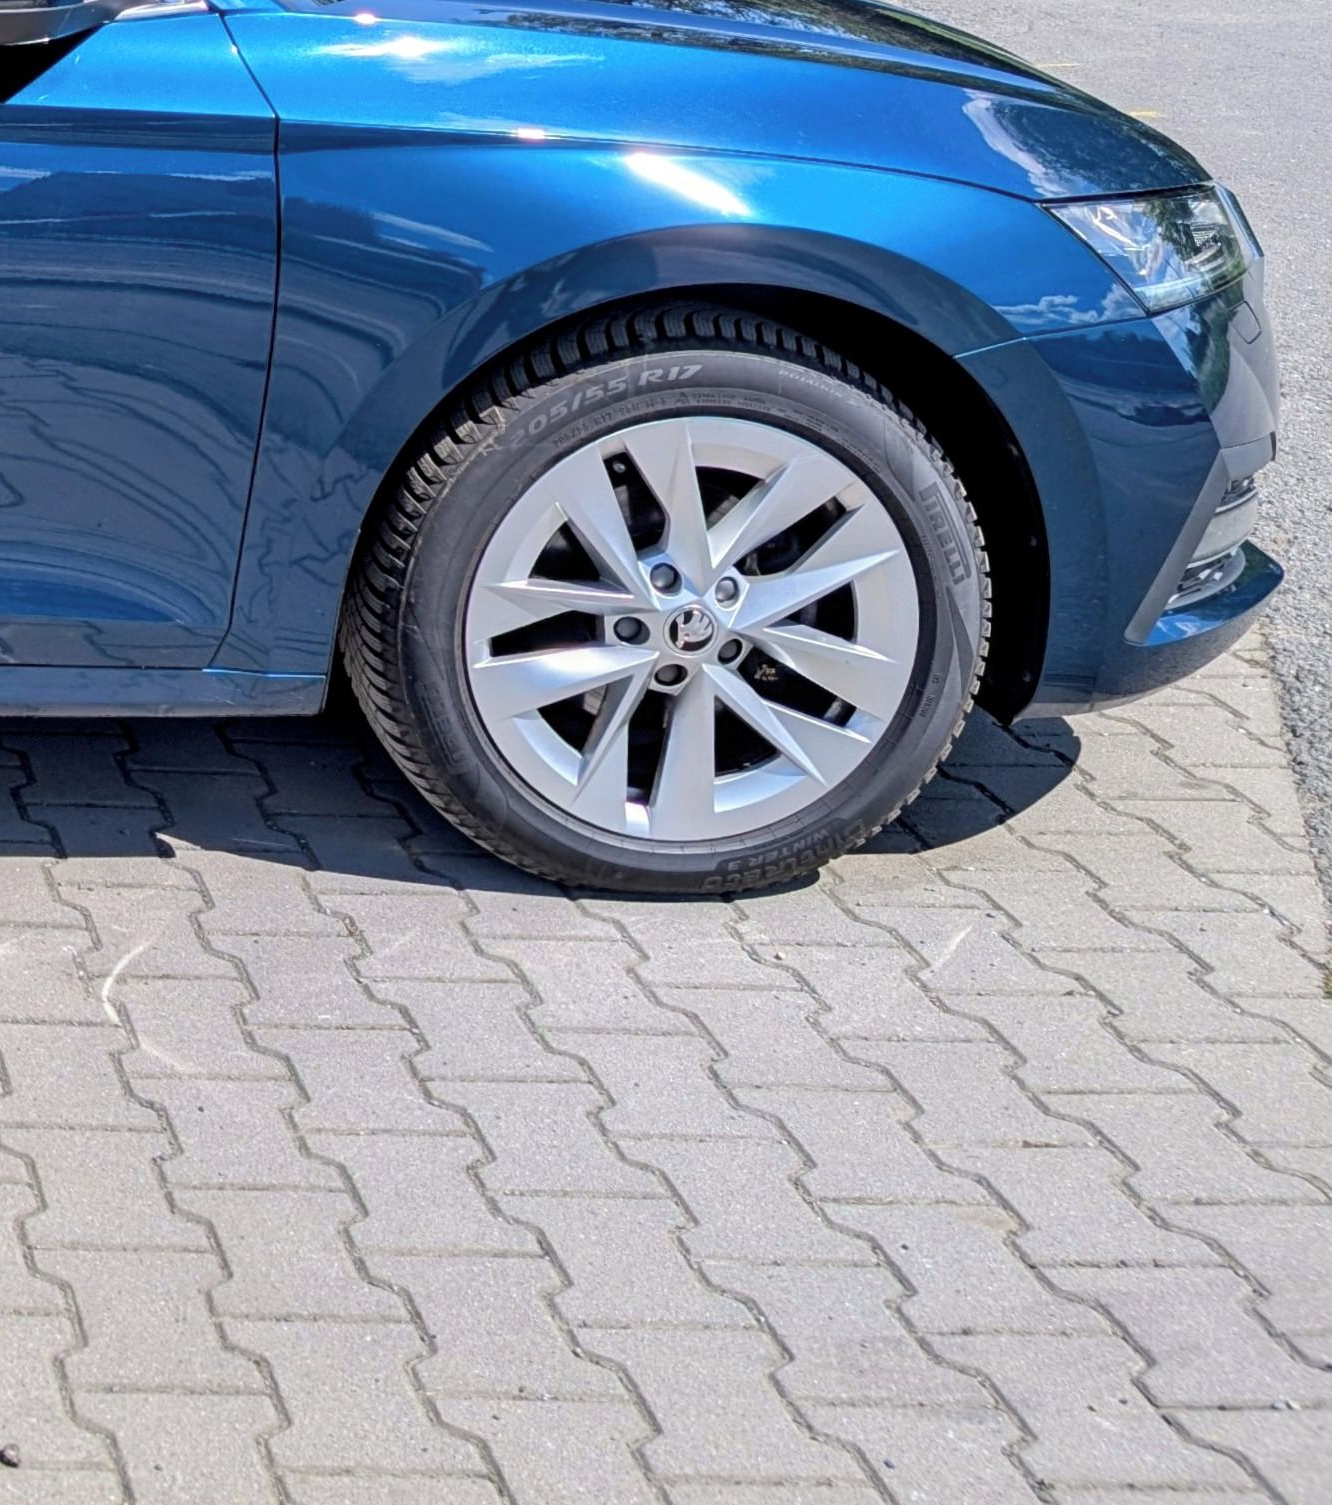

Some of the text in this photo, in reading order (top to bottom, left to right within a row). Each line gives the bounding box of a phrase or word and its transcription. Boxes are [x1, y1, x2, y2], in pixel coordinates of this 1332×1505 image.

[509, 375, 629, 447] 205/55
[638, 364, 704, 386] R17
[918, 481, 973, 586] PIRELLI
[747, 828, 830, 866] WINTER
